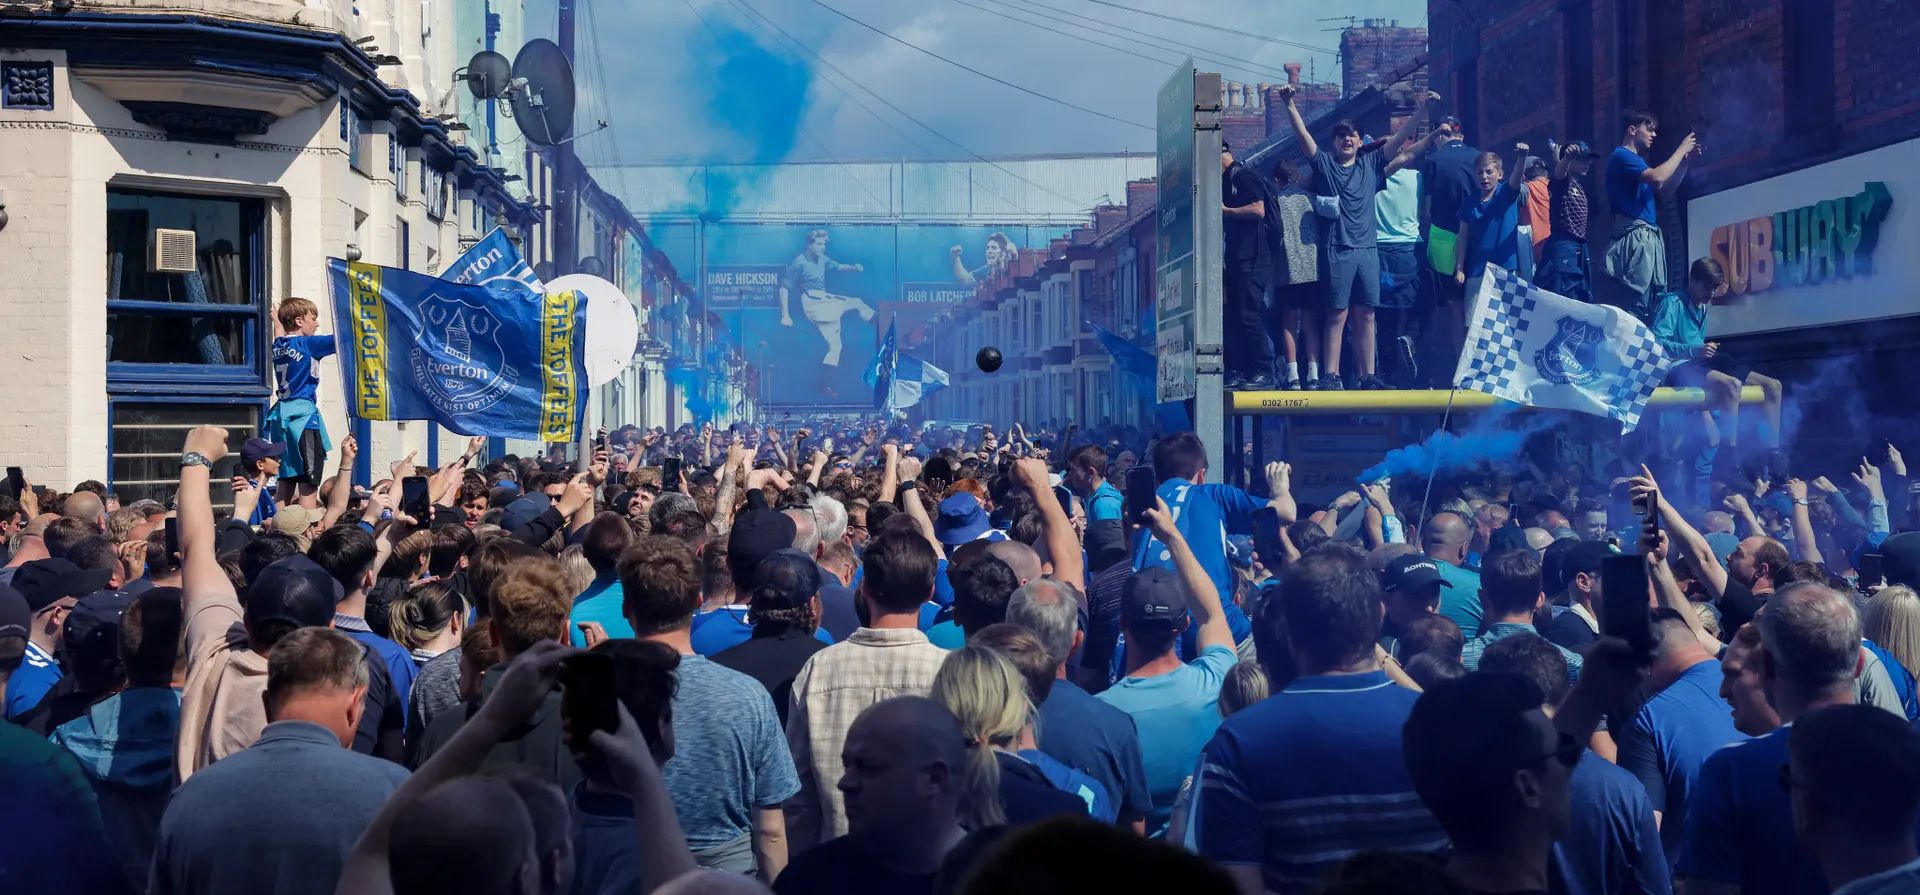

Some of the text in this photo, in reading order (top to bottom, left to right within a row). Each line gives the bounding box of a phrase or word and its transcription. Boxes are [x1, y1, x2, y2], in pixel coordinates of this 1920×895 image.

[1710, 182, 1893, 297] SUBWAY
[453, 247, 503, 284] erton
[708, 272, 778, 285] DAVE HICKSON
[907, 290, 927, 302] BOB
[355, 270, 380, 413] THE TOFFEES
[428, 357, 488, 379] Everton
[548, 300, 569, 434] THE TOFFEES
[445, 379, 464, 390] 1878
[467, 381, 511, 410] OPTIMUM
[1262, 399, 1281, 407] 0302
